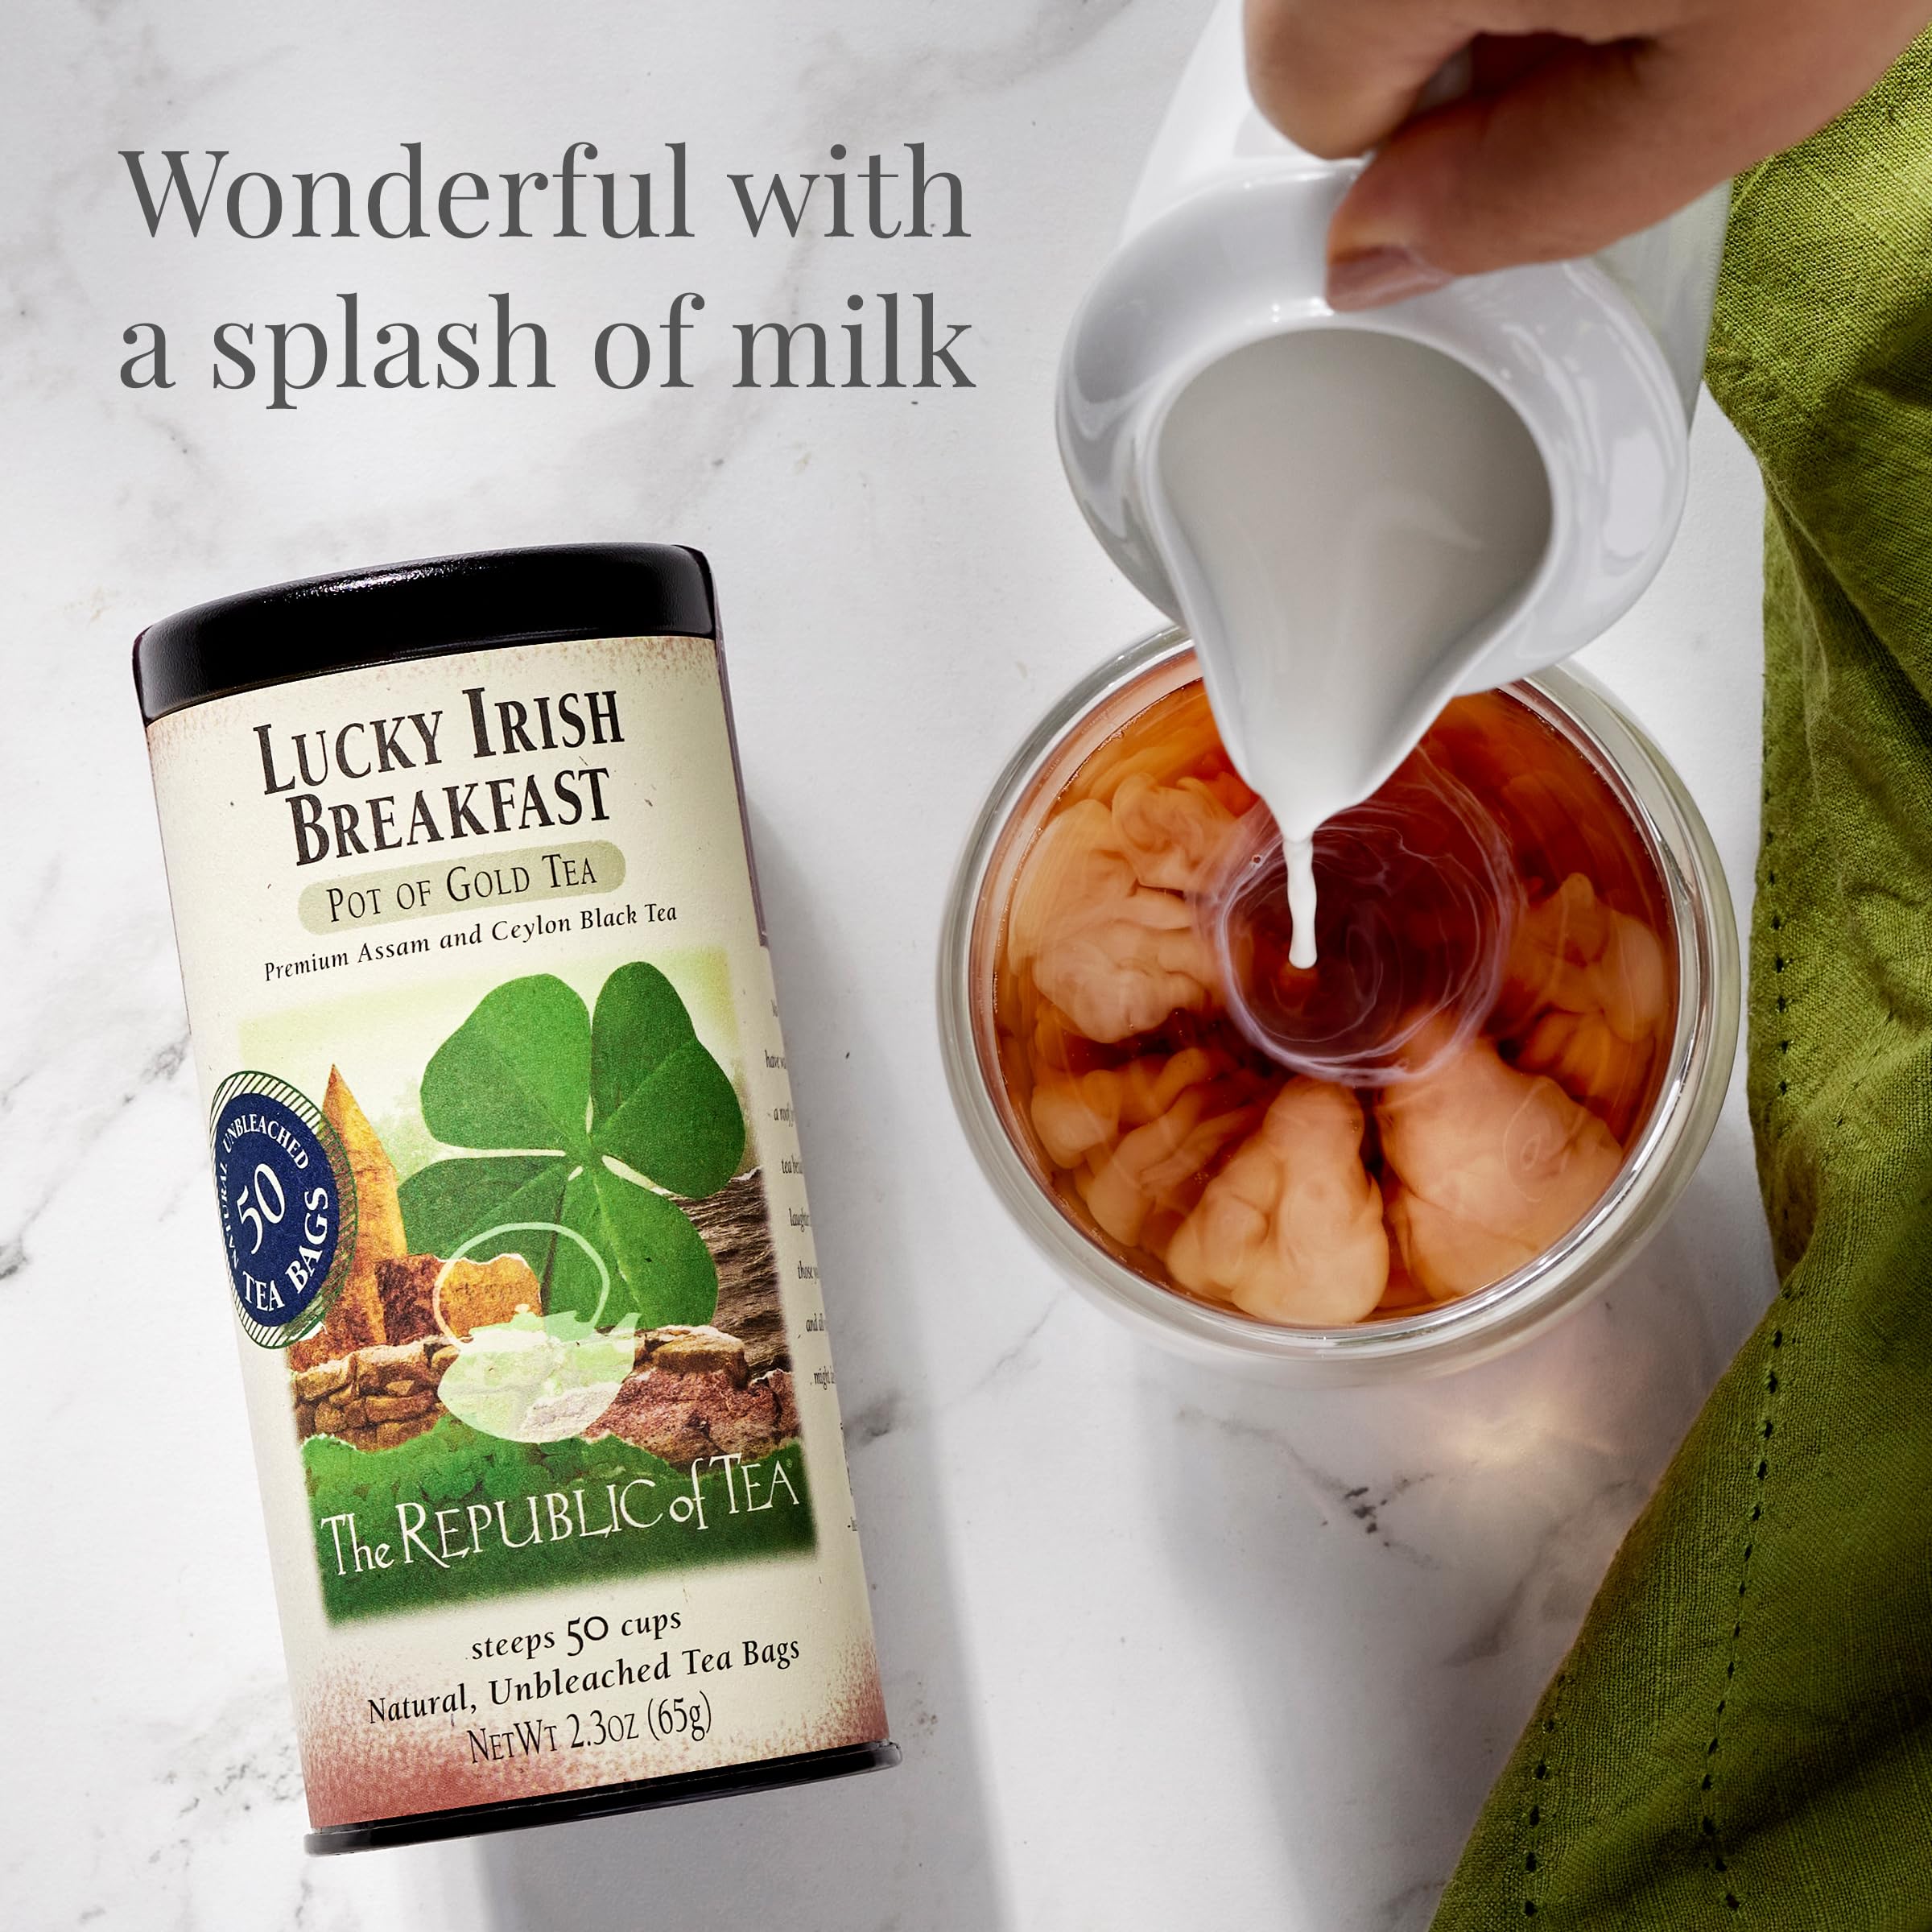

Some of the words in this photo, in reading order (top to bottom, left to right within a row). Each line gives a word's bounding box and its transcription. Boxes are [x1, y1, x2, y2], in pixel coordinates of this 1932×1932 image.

[254, 711, 443, 795] LUCKY
[462, 687, 625, 758] IRISH
[286, 768, 609, 865] BREAKFAST
[326, 888, 380, 922] POT
[397, 881, 430, 909] OF
[447, 866, 529, 901] GOLD
[542, 854, 597, 888] TEA
[266, 953, 348, 980] Premium
[359, 939, 429, 962] Assam
[440, 923, 481, 948] and
[493, 915, 571, 943] Ceylon
[581, 905, 637, 929] Black
[645, 904, 676, 922] Tea
[222, 1114, 309, 1170] UNBLEACHED
[237, 1164, 285, 1254] 50
[243, 1271, 285, 1311] TEA
[285, 1187, 328, 1294] BAGS
[321, 1513, 394, 1575] The
[395, 1480, 662, 1567] REPUBLIC
[670, 1458, 708, 1530] of
[709, 1453, 799, 1513] TEA
[473, 1633, 555, 1659] steeps
[568, 1616, 608, 1656] 50
[621, 1612, 680, 1640] cups
[368, 1683, 476, 1724] Natural,
[489, 1652, 671, 1704] Unbleached
[682, 1649, 733, 1674] Tea
[742, 1641, 799, 1669] Bags
[648, 1691, 711, 1741] (65g)
